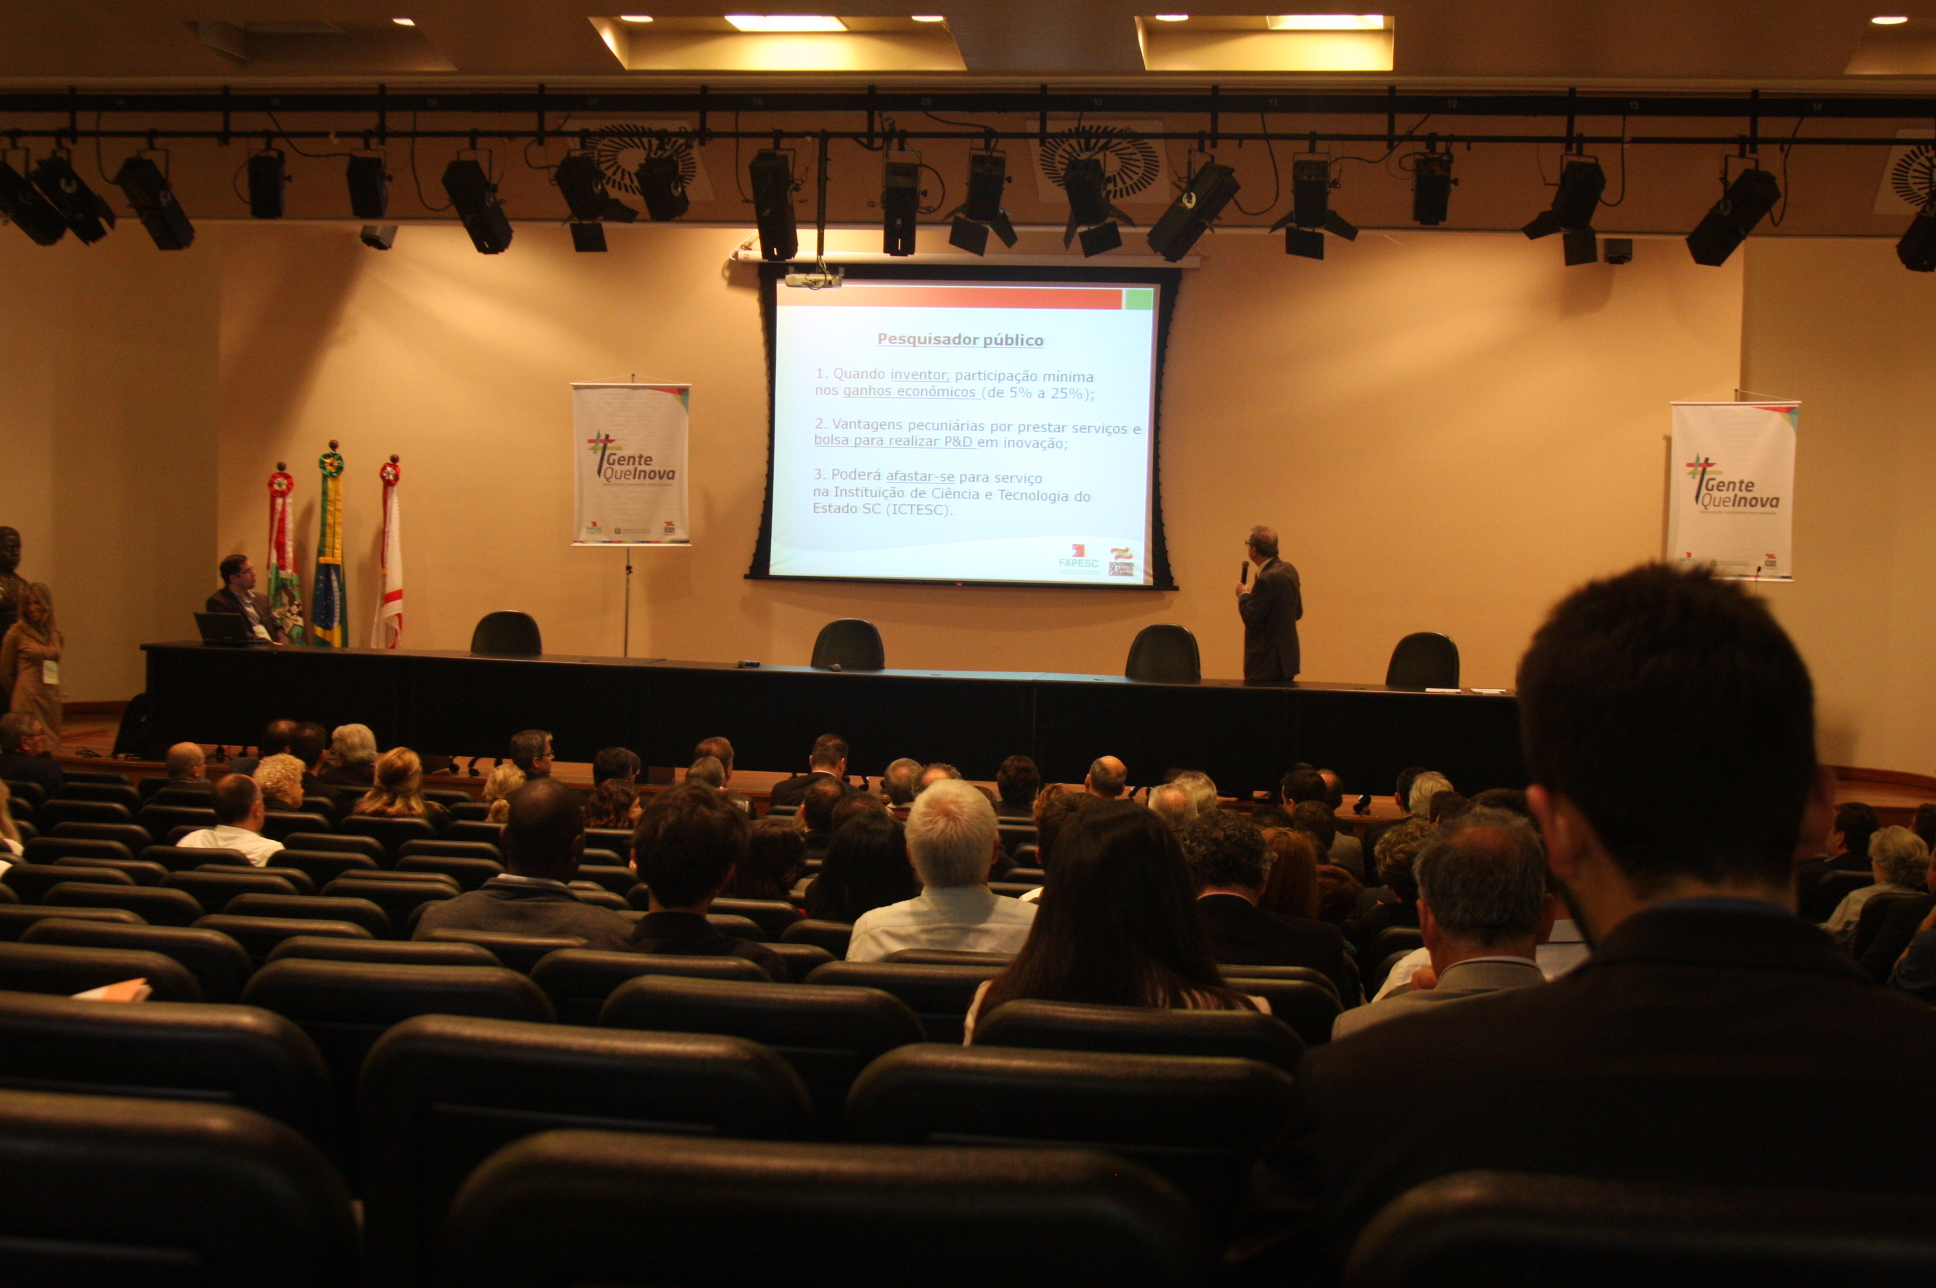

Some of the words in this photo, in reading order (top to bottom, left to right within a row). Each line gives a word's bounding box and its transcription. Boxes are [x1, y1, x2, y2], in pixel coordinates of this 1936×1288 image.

[921, 97, 932, 107] 09
[1094, 98, 1103, 107] 10
[1269, 98, 1278, 107] 11
[1448, 99, 1458, 108] 12
[1630, 101, 1639, 110] 13
[877, 332, 979, 348] Pesquisador
[983, 333, 1044, 349] público
[816, 368, 828, 379] 1.
[833, 368, 885, 381] Quando
[890, 368, 950, 383] inventor,
[955, 370, 1038, 384] participação
[1043, 370, 1094, 383] mínima
[815, 386, 838, 396] nos
[843, 385, 892, 398] ganhos
[897, 385, 976, 398] econômicos
[981, 386, 1004, 400] (de
[1009, 387, 1032, 399] 5%
[1037, 389, 1045, 399] a
[1051, 387, 1095, 402] 25%);
[814, 418, 828, 430] 2.
[832, 418, 902, 432] Vantagens
[908, 419, 985, 432] pecuniárias
[990, 422, 1013, 434] por
[1018, 422, 1067, 435] prestar
[1072, 423, 1127, 436] serviços
[1132, 425, 1141, 435] e
[814, 434, 849, 446] bolsa
[854, 436, 884, 448] para
[889, 435, 939, 447] realizar
[944, 436, 973, 447] P&D
[977, 438, 998, 448] em
[1003, 437, 1069, 451] inovação;
[606, 453, 653, 467] Gente
[603, 466, 676, 482] QueInova
[814, 468, 826, 480] 3.
[831, 468, 881, 481] Poderá
[886, 470, 955, 483] afastar-se
[959, 473, 989, 485] para
[994, 473, 1042, 486] serviço
[1705, 477, 1755, 492] Gente
[813, 487, 829, 497] na
[834, 486, 904, 500] Instituição
[910, 487, 926, 499] de
[931, 487, 979, 500] Ciência
[984, 490, 993, 500] e
[997, 489, 1068, 504] Tecnologia
[1074, 491, 1091, 502] do
[1701, 492, 1780, 510] QueInova
[813, 502, 858, 514] Estado
[862, 503, 881, 515] SC
[886, 503, 954, 518] (ICTESC).
[1059, 558, 1099, 568] FAPESC
